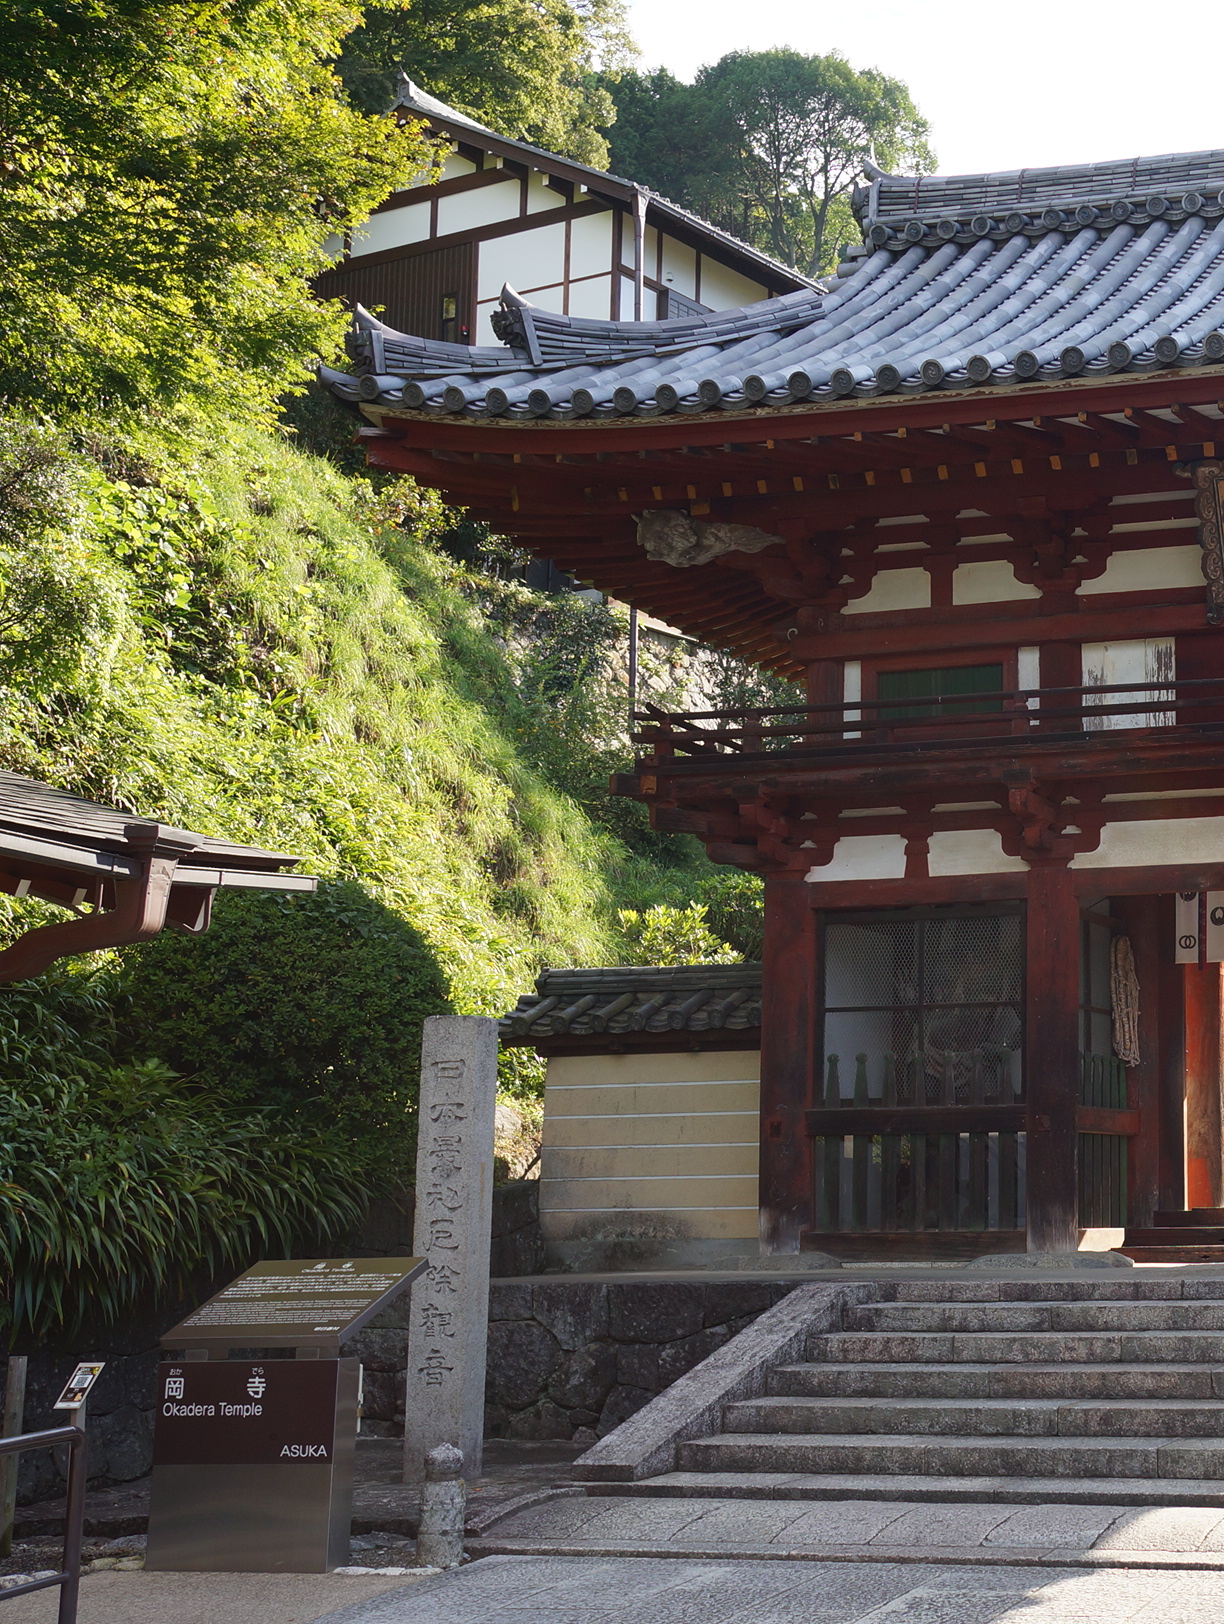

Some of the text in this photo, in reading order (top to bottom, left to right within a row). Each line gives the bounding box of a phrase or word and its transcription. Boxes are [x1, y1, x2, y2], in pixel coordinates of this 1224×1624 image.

[169, 1367, 264, 1376] おか でら
[165, 1376, 267, 1399] 岡 寺
[162, 1402, 263, 1418] Okadera Temple
[280, 1444, 327, 1458] ASUKA
